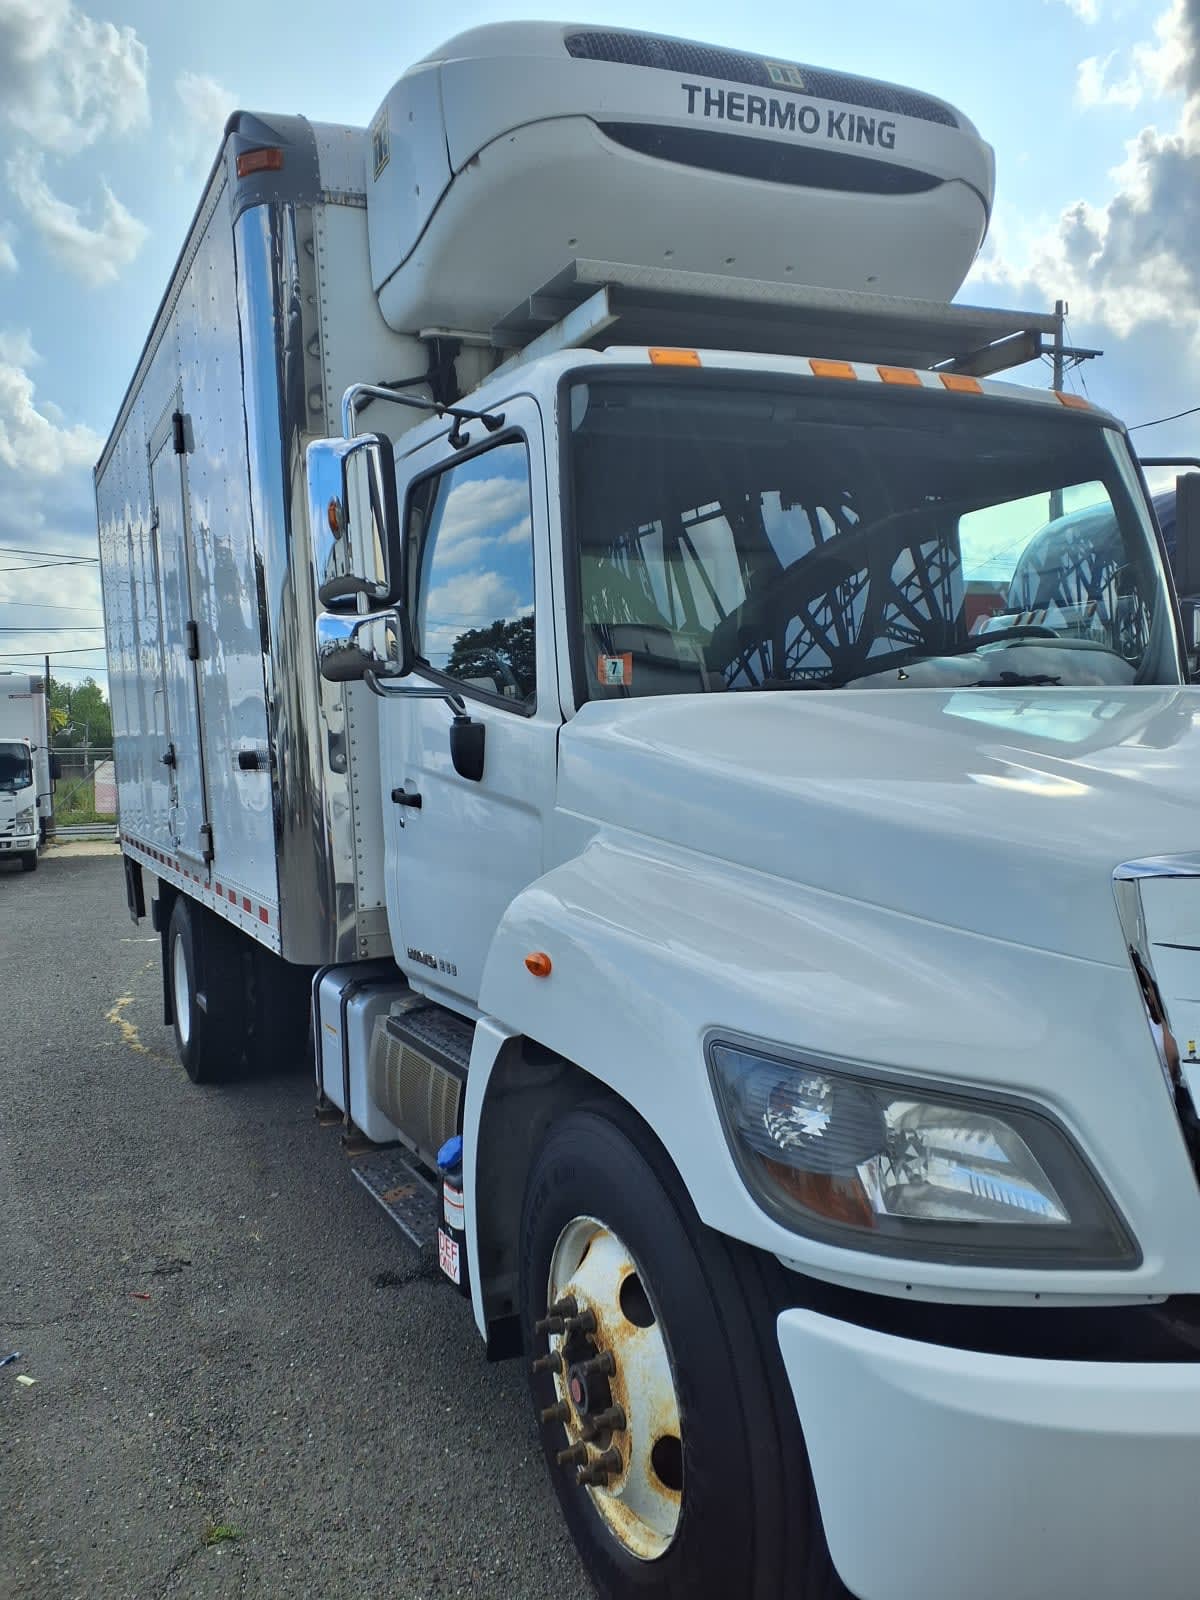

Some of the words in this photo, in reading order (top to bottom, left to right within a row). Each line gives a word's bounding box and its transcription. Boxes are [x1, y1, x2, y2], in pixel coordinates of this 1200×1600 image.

[681, 83, 821, 134] THERMO
[827, 110, 896, 150] KING
[611, 661, 618, 675] 7
[439, 1231, 458, 1262] DEF
[440, 1251, 458, 1279] ONLY
